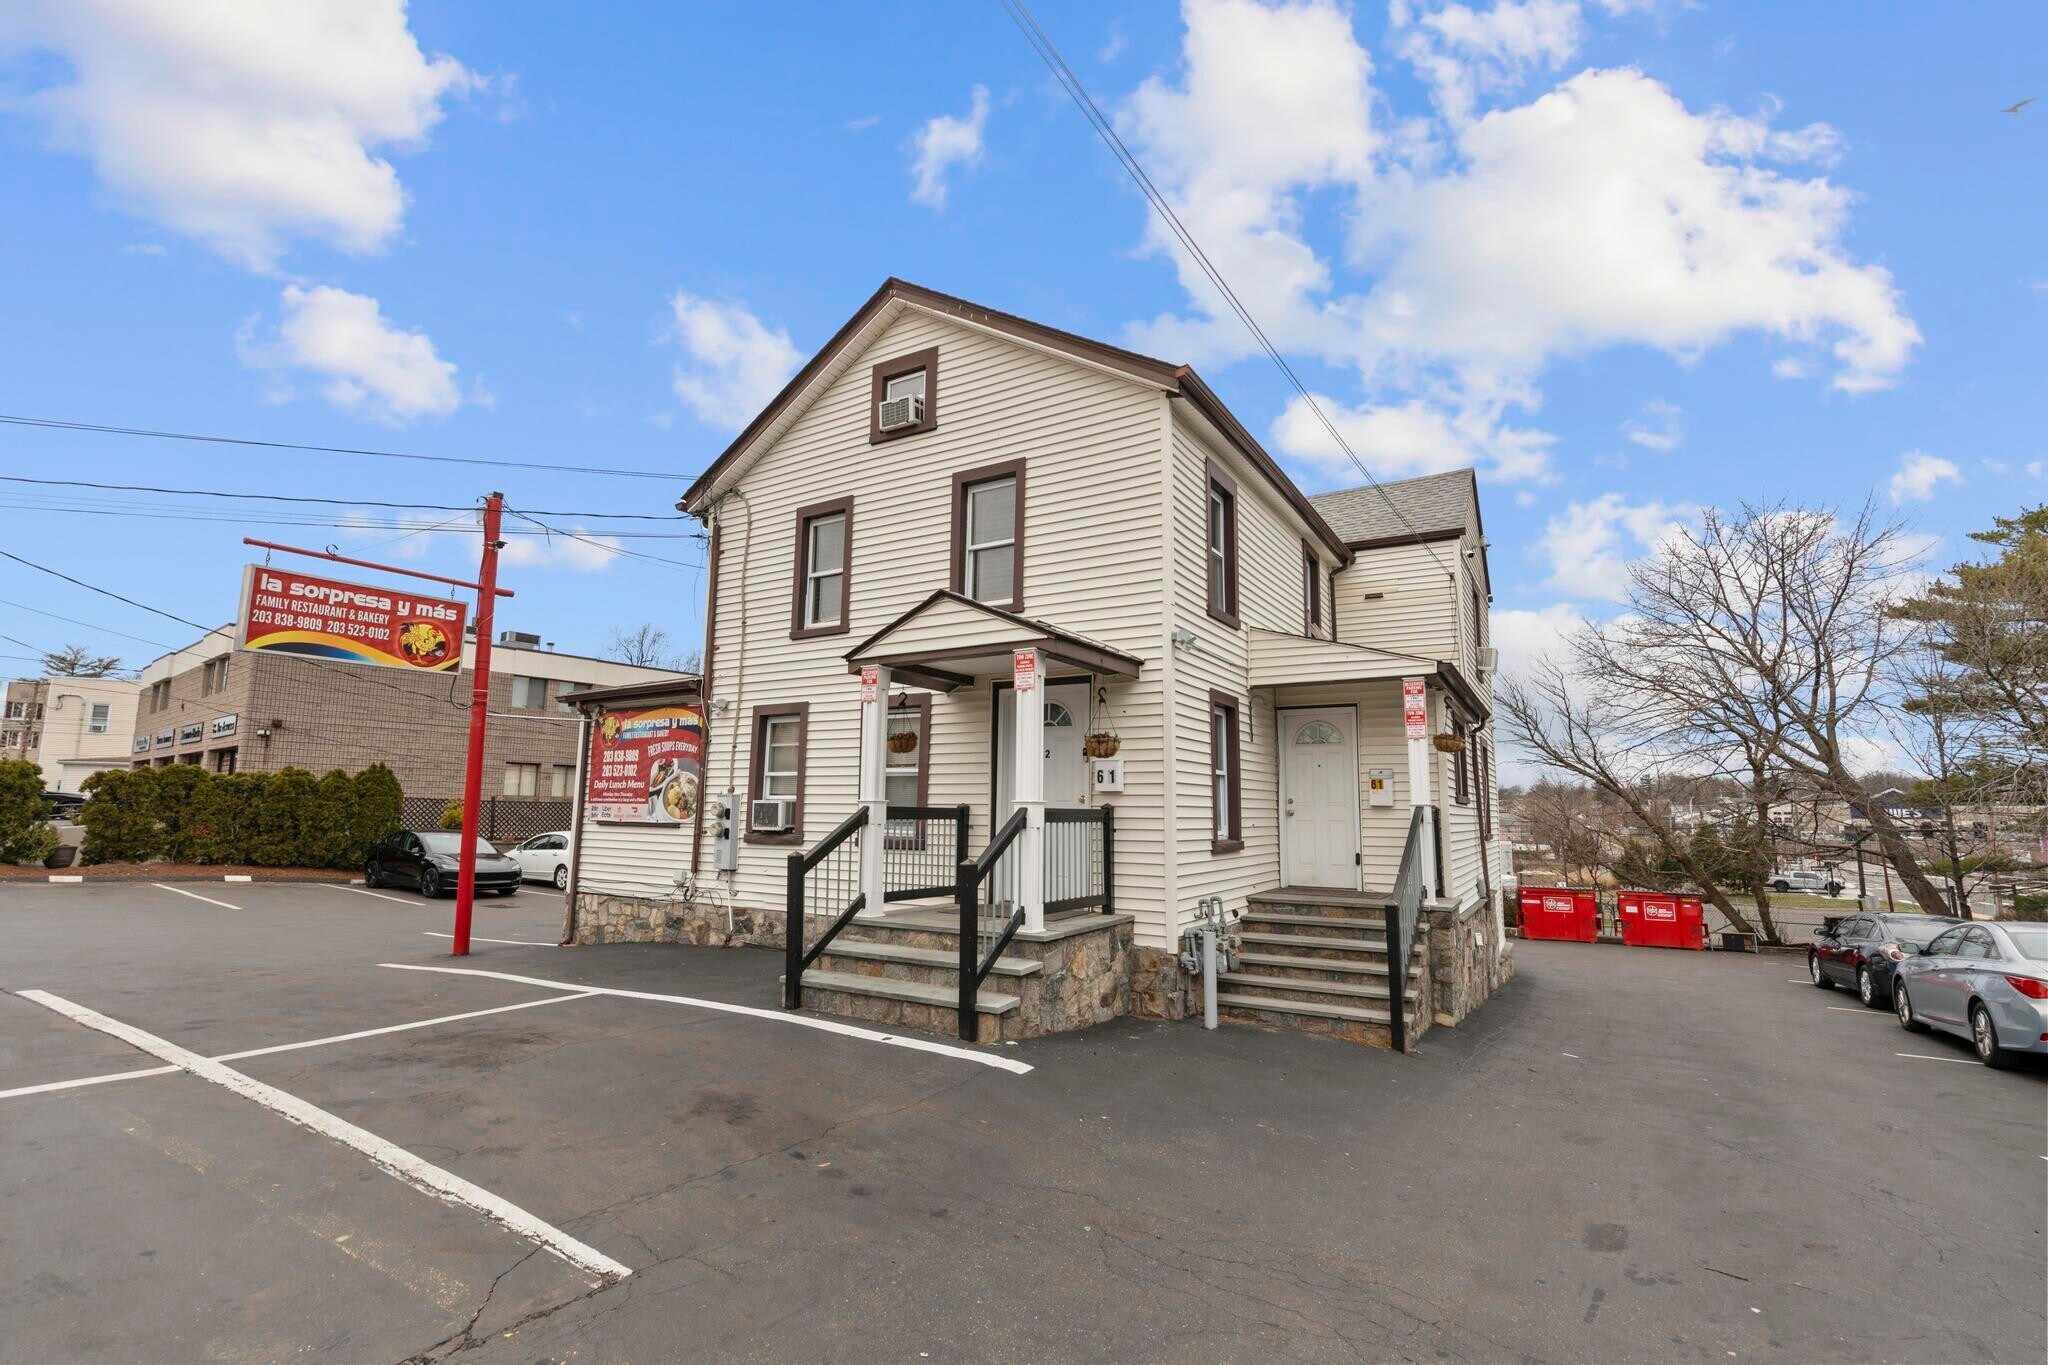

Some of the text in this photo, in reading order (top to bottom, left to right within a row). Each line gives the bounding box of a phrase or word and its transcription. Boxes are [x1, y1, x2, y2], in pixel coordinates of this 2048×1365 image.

[260, 573, 458, 621] la sorpresa y más
[255, 594, 390, 625] FAMILY RESTAURANT & BAKERY
[252, 609, 390, 640] 203 838-9809 203 523-0102
[624, 718, 632, 729] la
[633, 718, 670, 730] sorpresa
[671, 718, 678, 729] y
[675, 741, 699, 753] EVERYDAY
[603, 750, 614, 762] 203
[1044, 749, 1051, 758] 2
[593, 779, 645, 790] Daily Lunch Menu
[1371, 779, 1384, 790] 61
